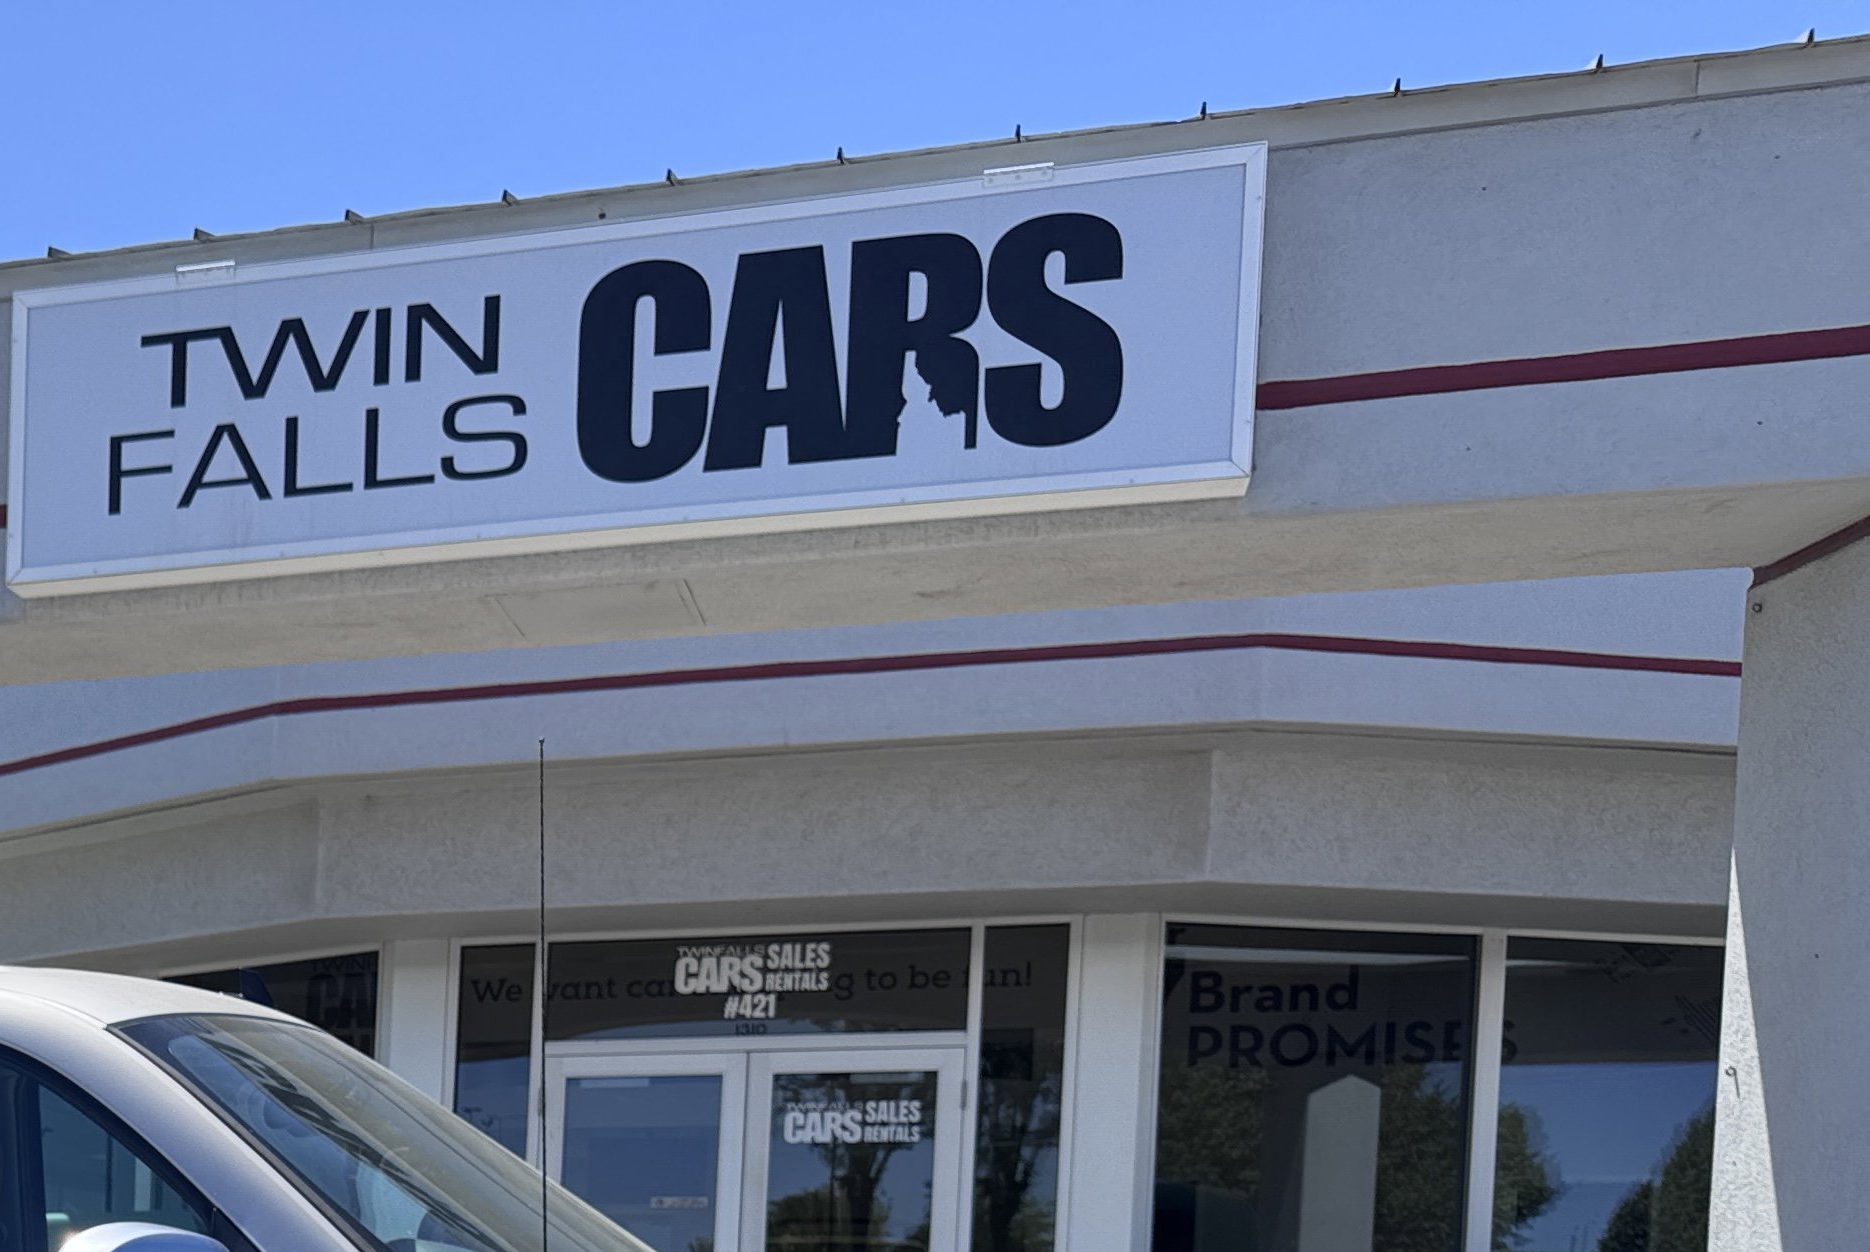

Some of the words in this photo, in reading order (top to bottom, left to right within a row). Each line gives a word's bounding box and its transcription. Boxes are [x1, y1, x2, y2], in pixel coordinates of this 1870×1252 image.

[141, 294, 501, 409] TWIN
[577, 213, 1124, 484] CARS
[107, 394, 529, 515] FALLS
[766, 941, 832, 969] SALES
[471, 978, 523, 1003] We
[866, 967, 898, 991] to
[909, 964, 951, 988] be
[962, 961, 1033, 987] un!
[675, 956, 765, 995] CARS
[765, 969, 829, 992] RENTALS
[1189, 963, 1359, 1014] Brand
[723, 993, 777, 1019] #421
[1187, 1018, 1518, 1068] PROMISES
[783, 1110, 863, 1144] CARS
[865, 1099, 922, 1123] SALES
[864, 1123, 921, 1144] RENTALS
